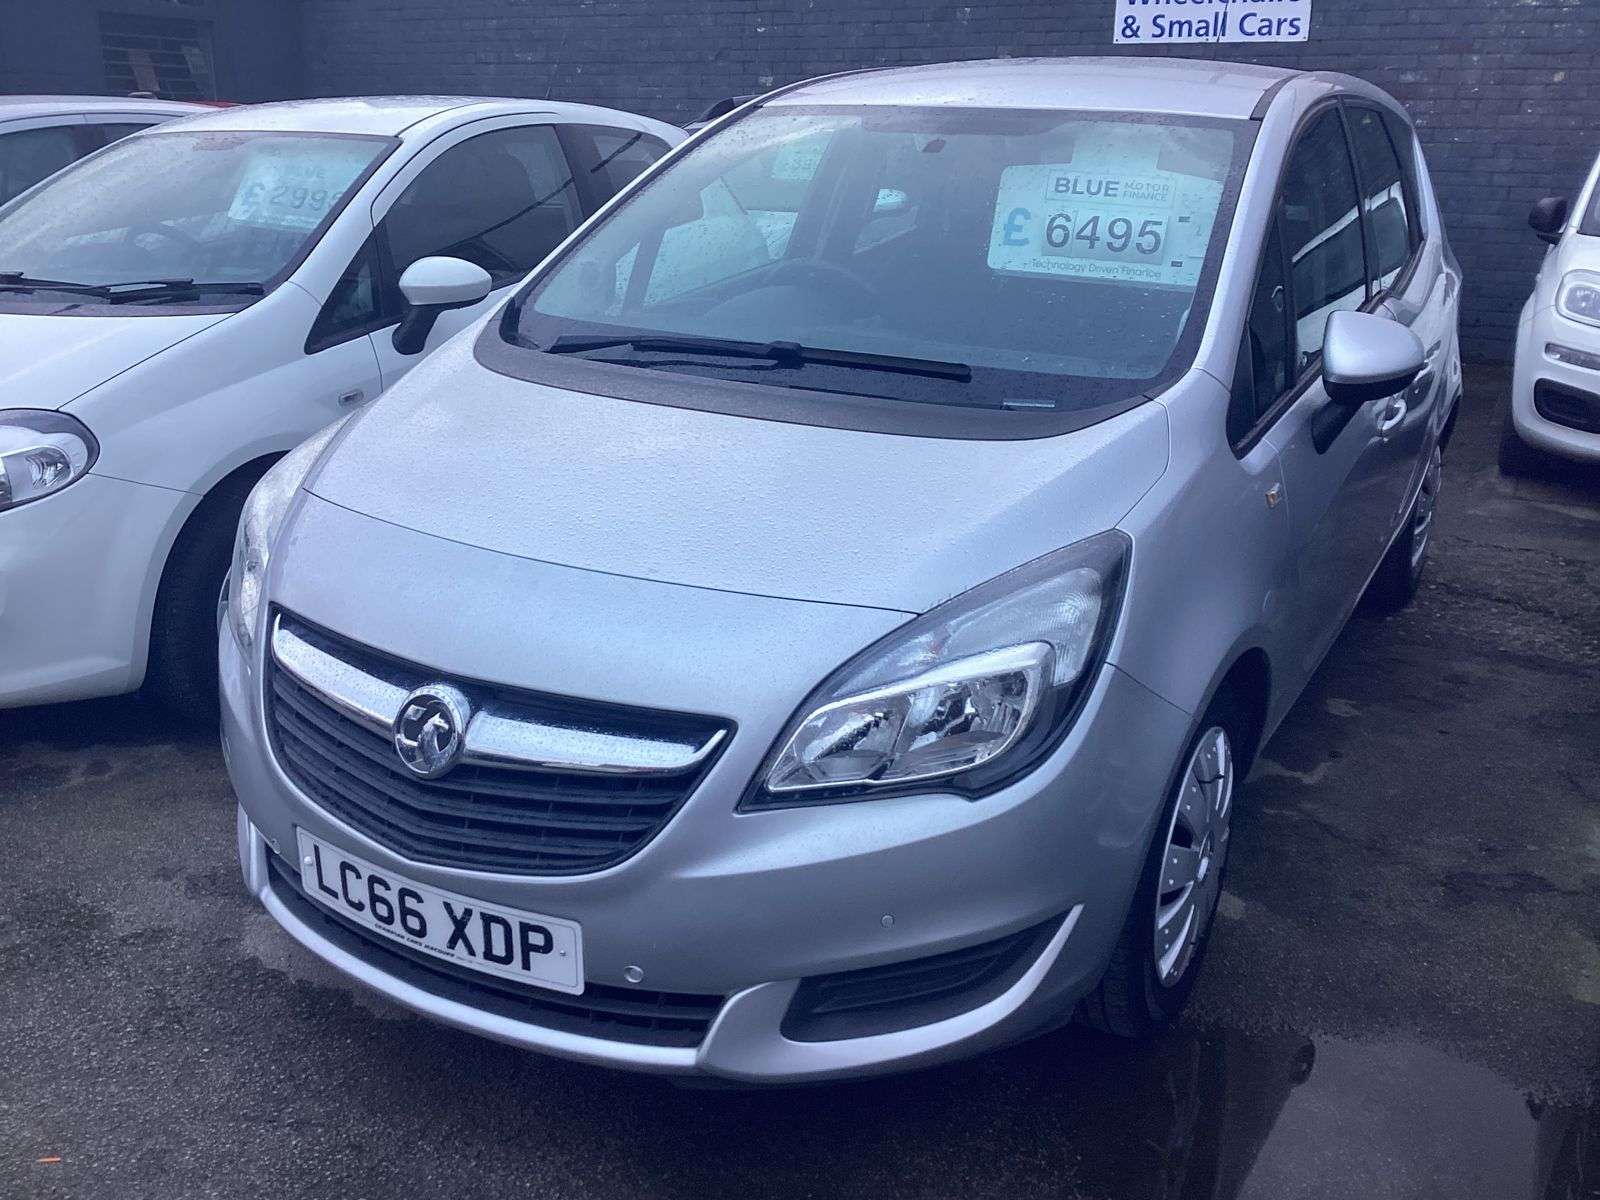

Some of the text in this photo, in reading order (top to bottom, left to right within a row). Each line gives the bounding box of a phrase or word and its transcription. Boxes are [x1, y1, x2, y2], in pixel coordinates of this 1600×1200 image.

[1121, 11, 1301, 39] & Small Cars
[1054, 176, 1120, 198] BLUE
[1124, 178, 1170, 192] MOTOR
[1123, 190, 1169, 202] FINANCE
[1032, 259, 1162, 279] Technology Driven Finance
[313, 843, 554, 971] LC66 XDP
